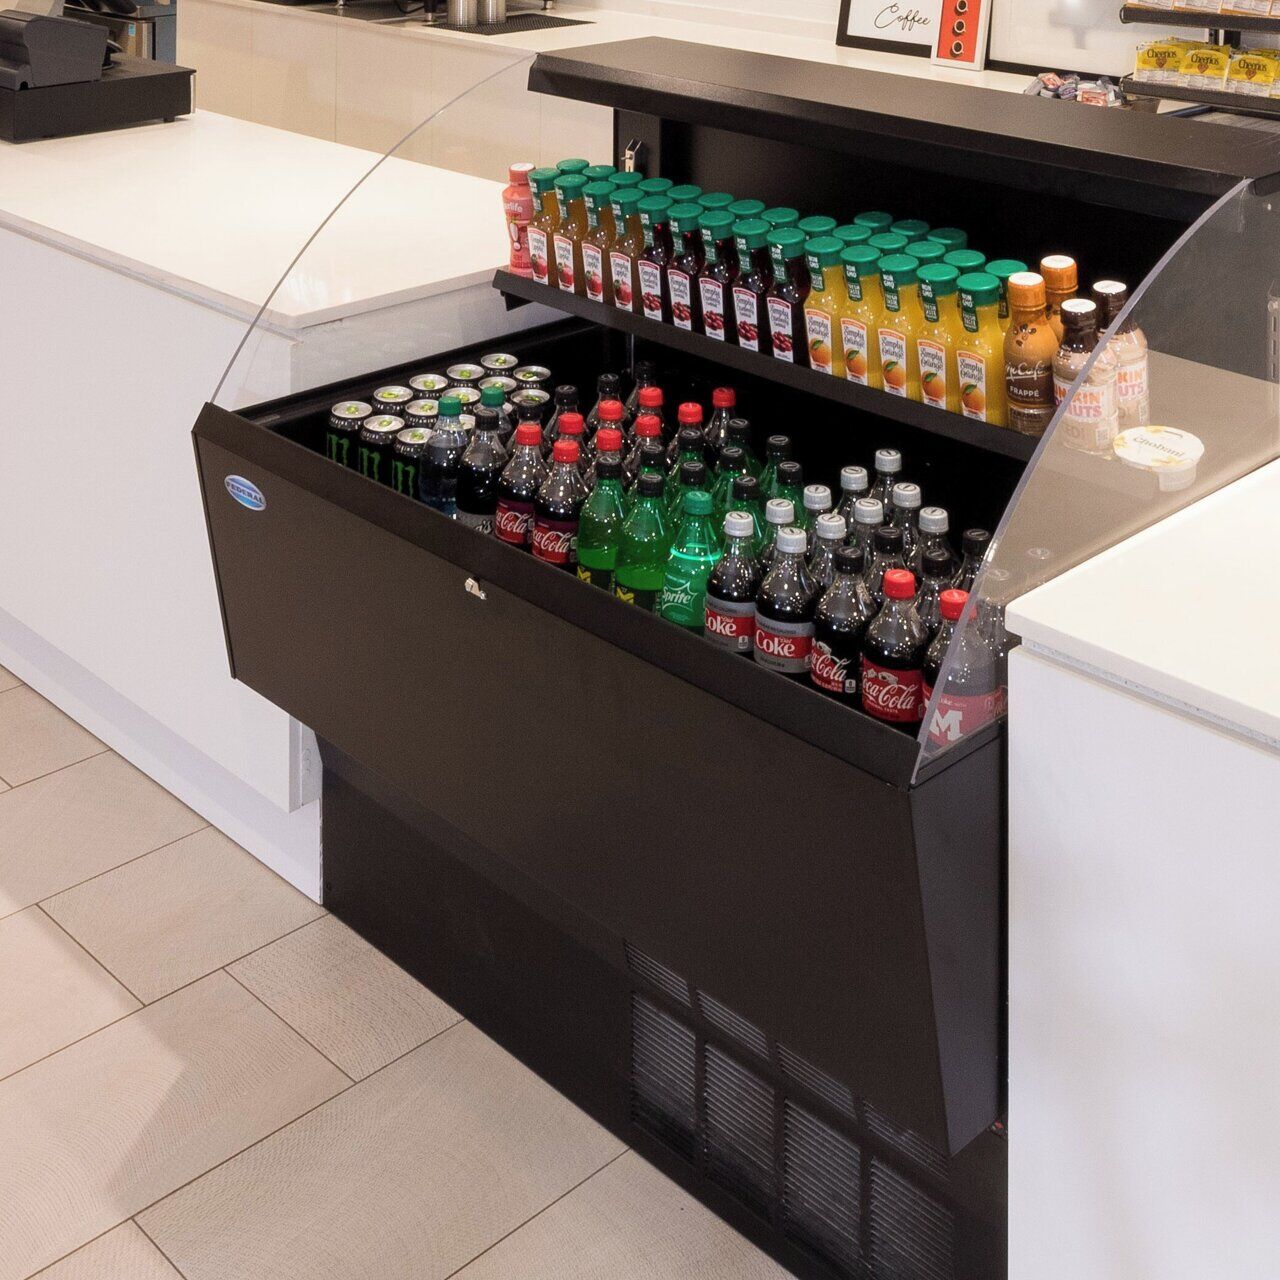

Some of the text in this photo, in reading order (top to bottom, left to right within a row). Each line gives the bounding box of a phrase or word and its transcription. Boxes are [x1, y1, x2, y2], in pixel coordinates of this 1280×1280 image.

[874, 2, 930, 32] Coffee
[1147, 48, 1177, 60] Cheerios
[1191, 52, 1219, 65] Cheerios
[1238, 60, 1267, 72] Cheerios
[843, 326, 865, 341] Simply
[881, 337, 903, 352] Simply
[920, 348, 942, 363] Simply
[921, 358, 943, 371] Orange
[960, 359, 983, 376] Simply
[961, 370, 983, 383] Orange
[1010, 385, 1040, 397] FRAPPÉ
[226, 481, 264, 504] FEDERAL
[756, 629, 795, 657] Coke
[929, 710, 963, 741] M
